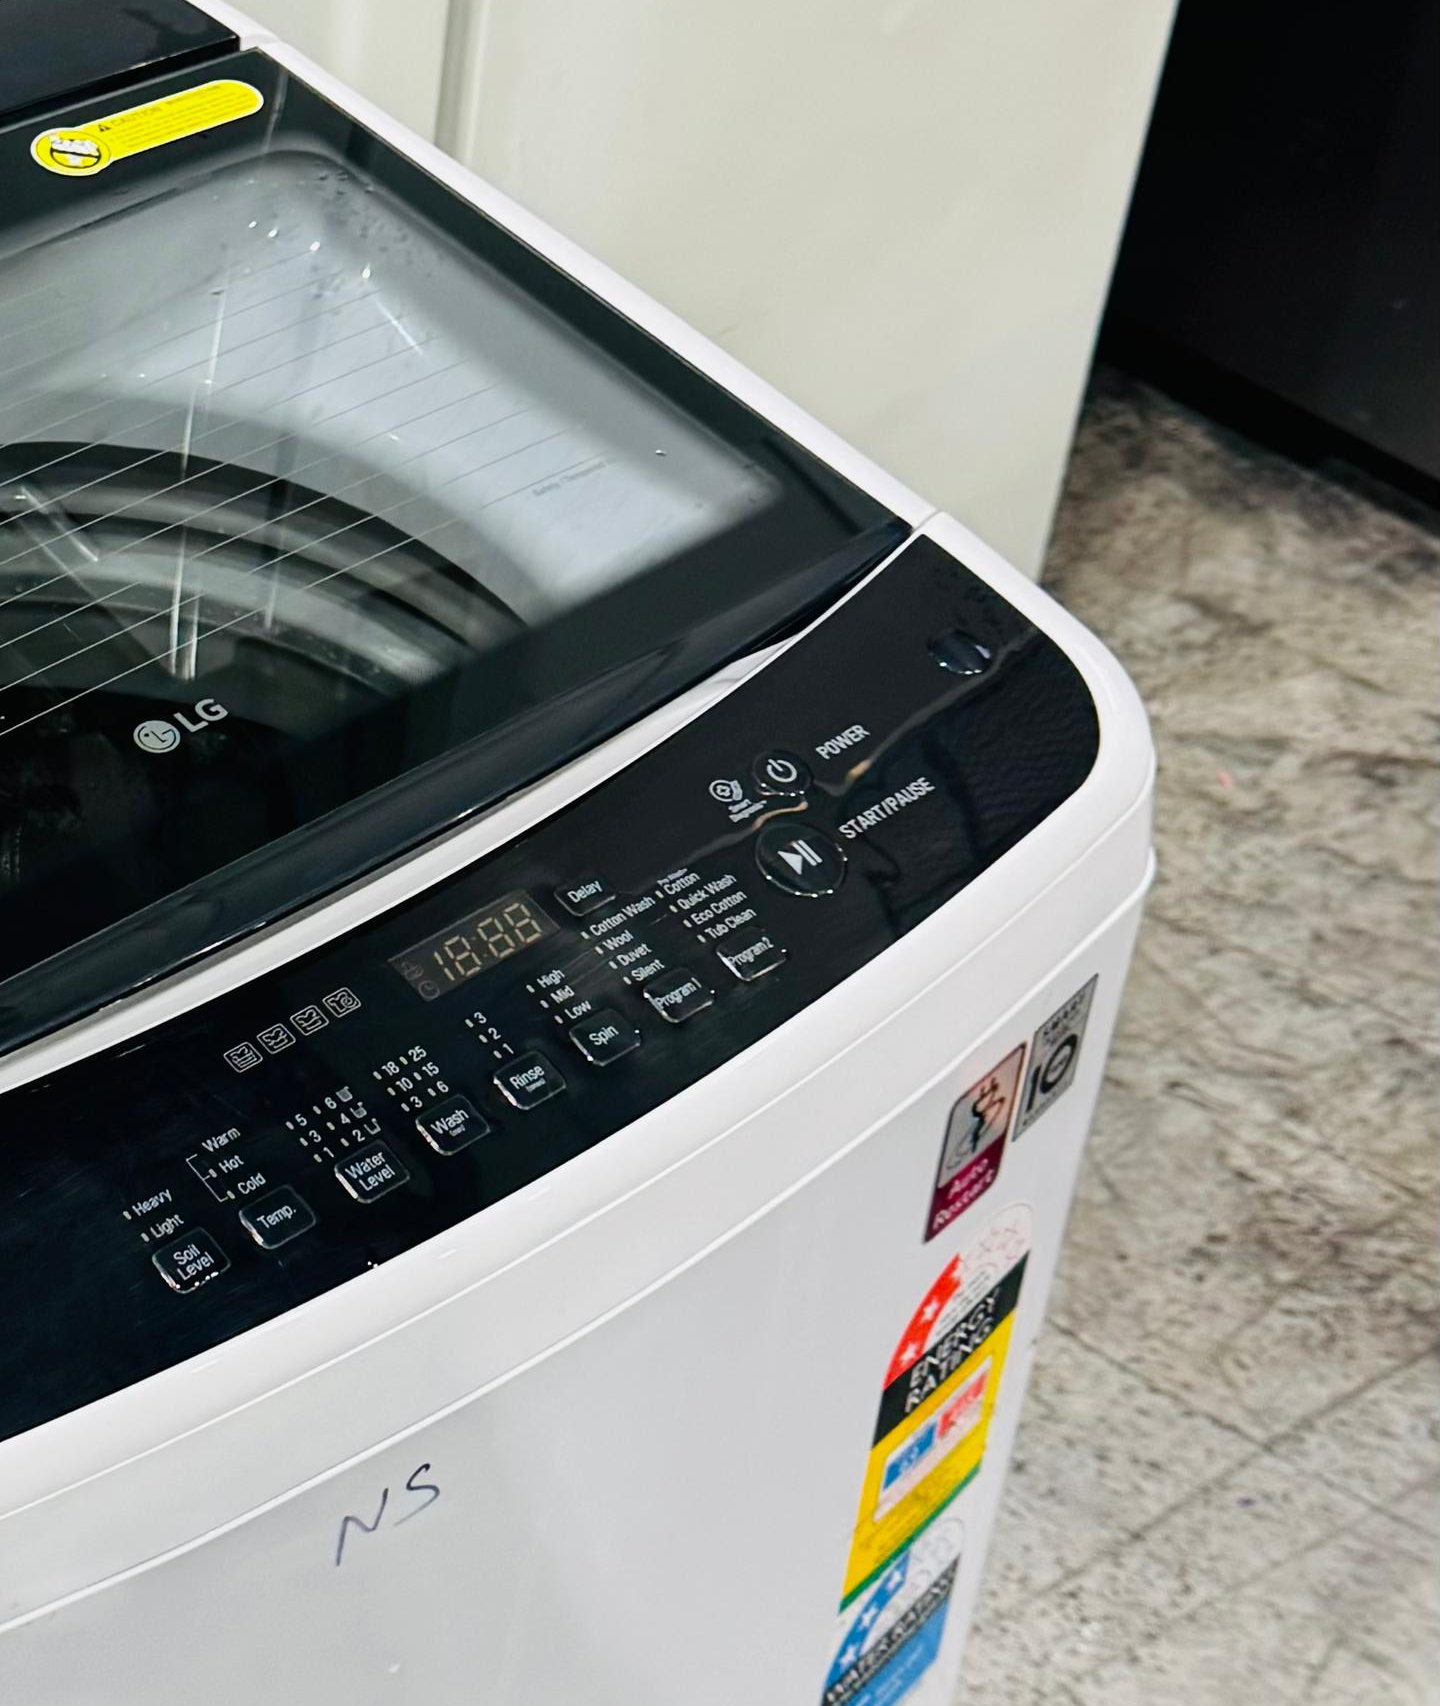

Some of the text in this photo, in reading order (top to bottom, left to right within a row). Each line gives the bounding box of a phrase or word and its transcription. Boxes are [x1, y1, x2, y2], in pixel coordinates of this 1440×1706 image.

[173, 698, 229, 733] LG
[815, 724, 871, 760] POWER
[838, 776, 936, 839] START/PAUSE
[567, 880, 603, 903] Delay
[663, 872, 701, 895] Cotton
[677, 889, 710, 910] Quick
[703, 874, 738, 895] Wash
[589, 896, 657, 936] Cotton Wash
[690, 891, 748, 925] Eco Cotton
[704, 908, 758, 939] Tub Clean
[602, 929, 634, 951] Wool
[616, 943, 653, 966] Duvet
[536, 969, 566, 988] High
[631, 959, 665, 982] Silent
[550, 984, 575, 1003] Mid
[473, 1011, 487, 1024] 3
[564, 1000, 592, 1020] Low
[488, 1027, 501, 1040] 2
[588, 1025, 620, 1046] Spin
[381, 1045, 427, 1076] 18 25
[502, 1043, 514, 1054] 1
[395, 1062, 439, 1092] 10 15
[509, 1065, 545, 1090] Rinse
[410, 1080, 449, 1108] 3 6
[294, 1096, 337, 1126] 5 6
[430, 1109, 470, 1134] Wash
[201, 1127, 241, 1152] Warm
[308, 1112, 351, 1143] 3 4
[323, 1129, 365, 1158] 1 2
[218, 1155, 245, 1174] Hot
[344, 1152, 386, 1179] Water
[358, 1163, 396, 1191] Level
[237, 1172, 267, 1195] Cold
[131, 1189, 173, 1217] Heavy
[150, 1214, 184, 1239] Light
[256, 1205, 297, 1228] Temp.
[173, 1243, 201, 1266] Soil
[176, 1251, 215, 1280] Level
[910, 1286, 1000, 1389] ENERGY
[904, 1316, 995, 1413] RATING
